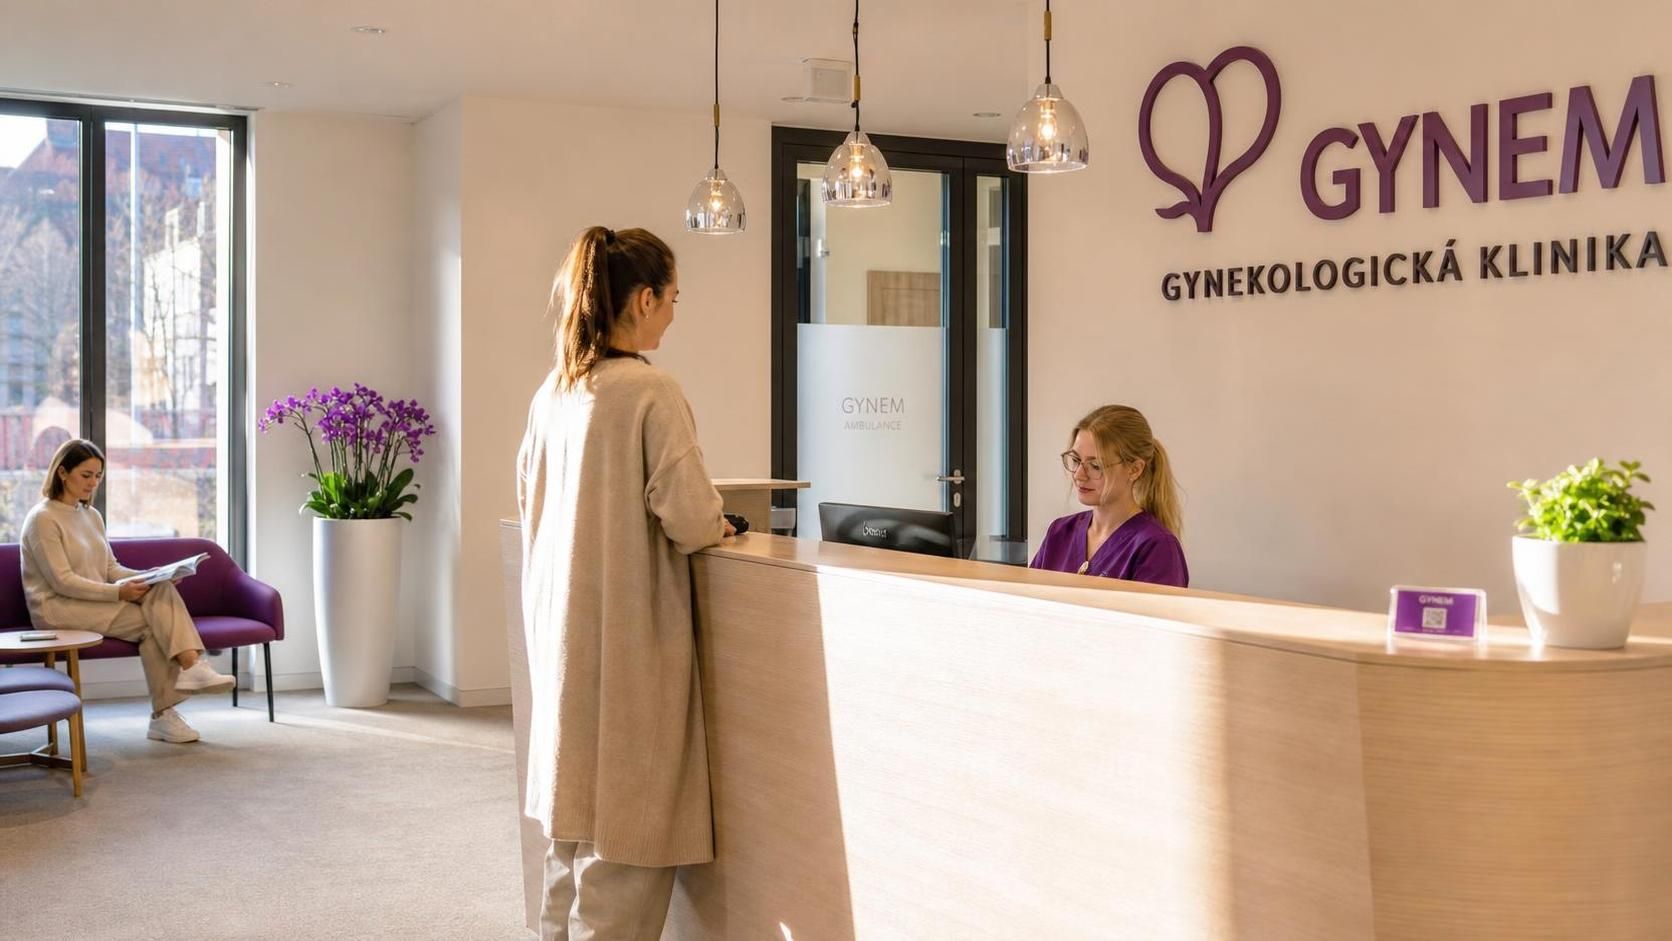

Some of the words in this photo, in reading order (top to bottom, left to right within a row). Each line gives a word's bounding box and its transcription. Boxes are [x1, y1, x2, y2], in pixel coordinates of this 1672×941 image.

[1300, 75, 1666, 220] GYNEM
[1161, 239, 1464, 302] GYNEKOLOGICKÁ
[1480, 231, 1668, 280] KLINIKA
[842, 396, 905, 414] GYNEM
[844, 421, 903, 431] AMBULANCE
